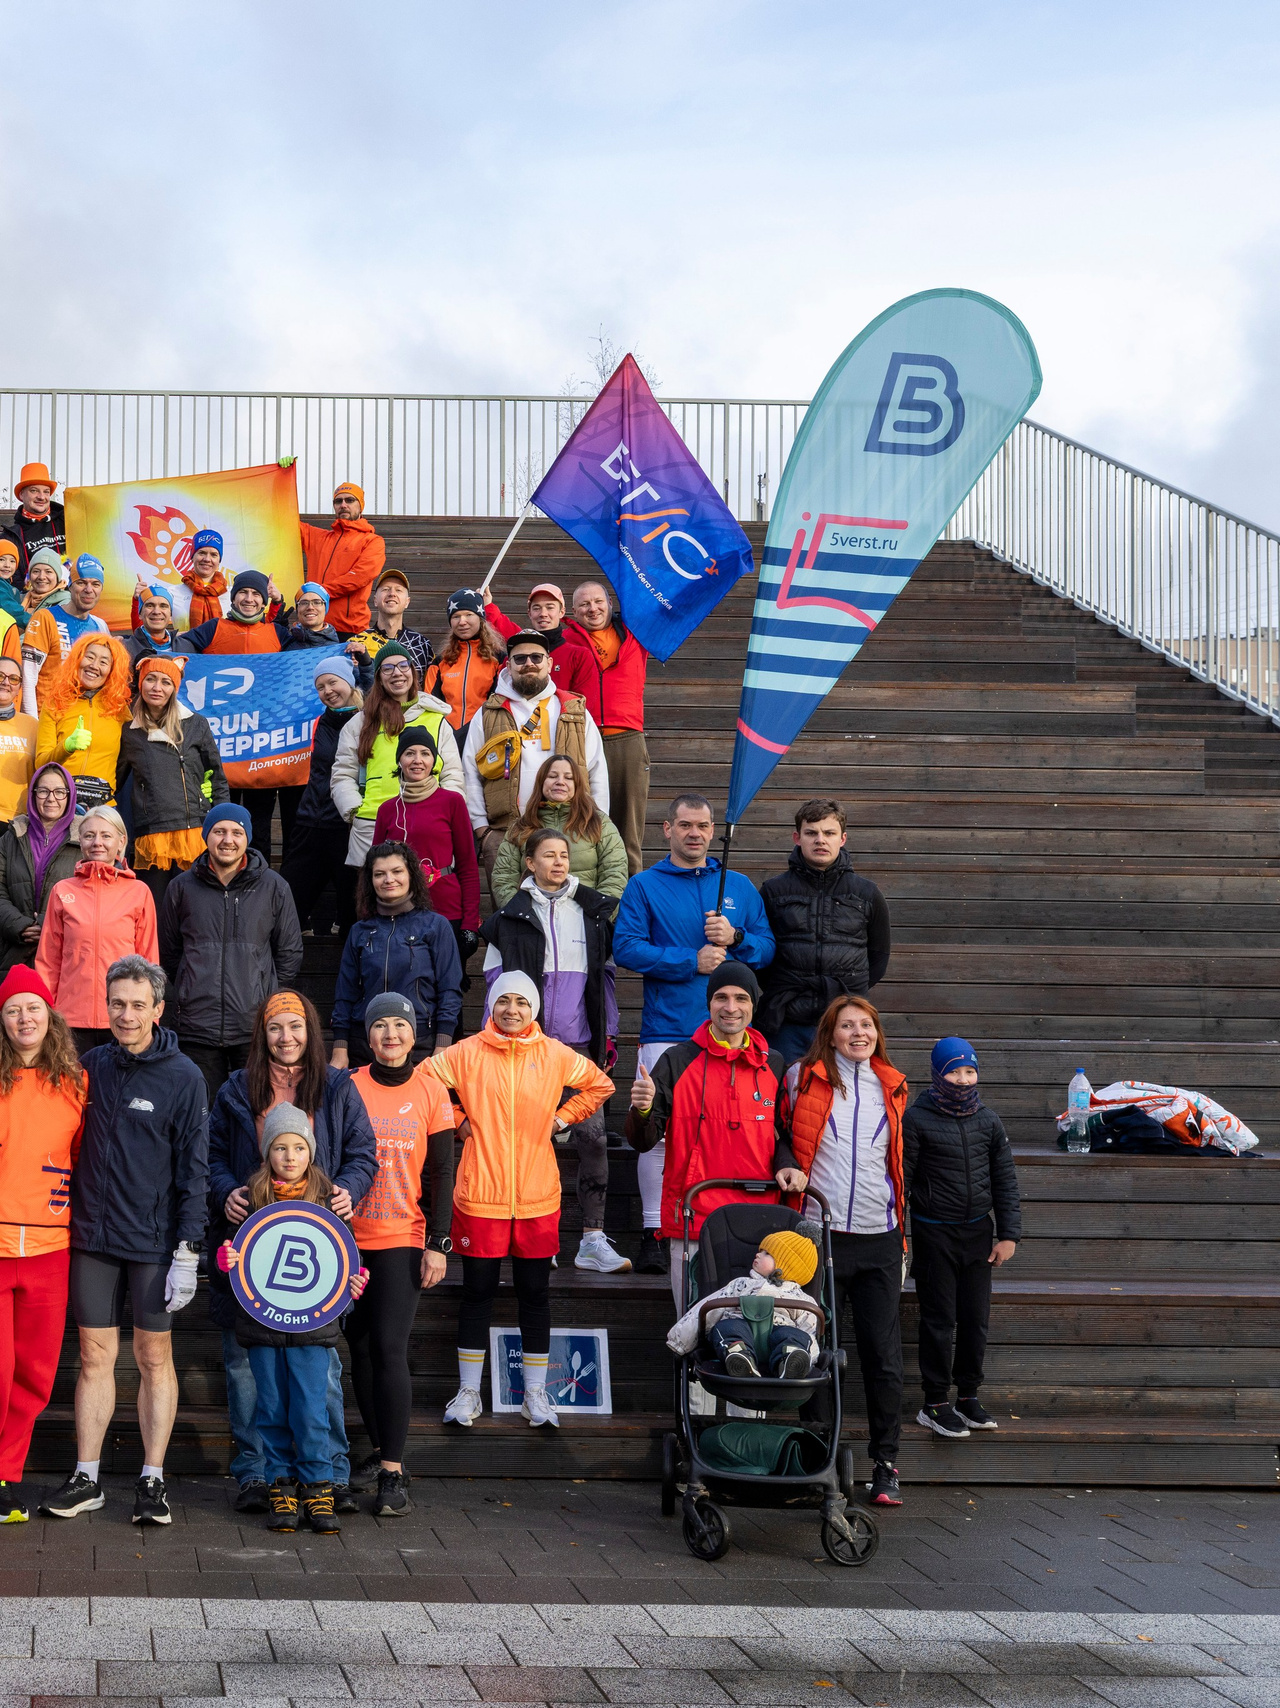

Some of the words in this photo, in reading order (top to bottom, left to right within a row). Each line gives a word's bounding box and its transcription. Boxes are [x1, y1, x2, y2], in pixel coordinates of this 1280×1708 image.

[830, 532, 898, 551] 5verst.ru
[638, 572, 651, 588] бега
[206, 710, 260, 736] RUN
[248, 751, 312, 772] Долгопрудн
[376, 1138, 415, 1151] ОВСКИЙ
[263, 1306, 309, 1324] Лобня
